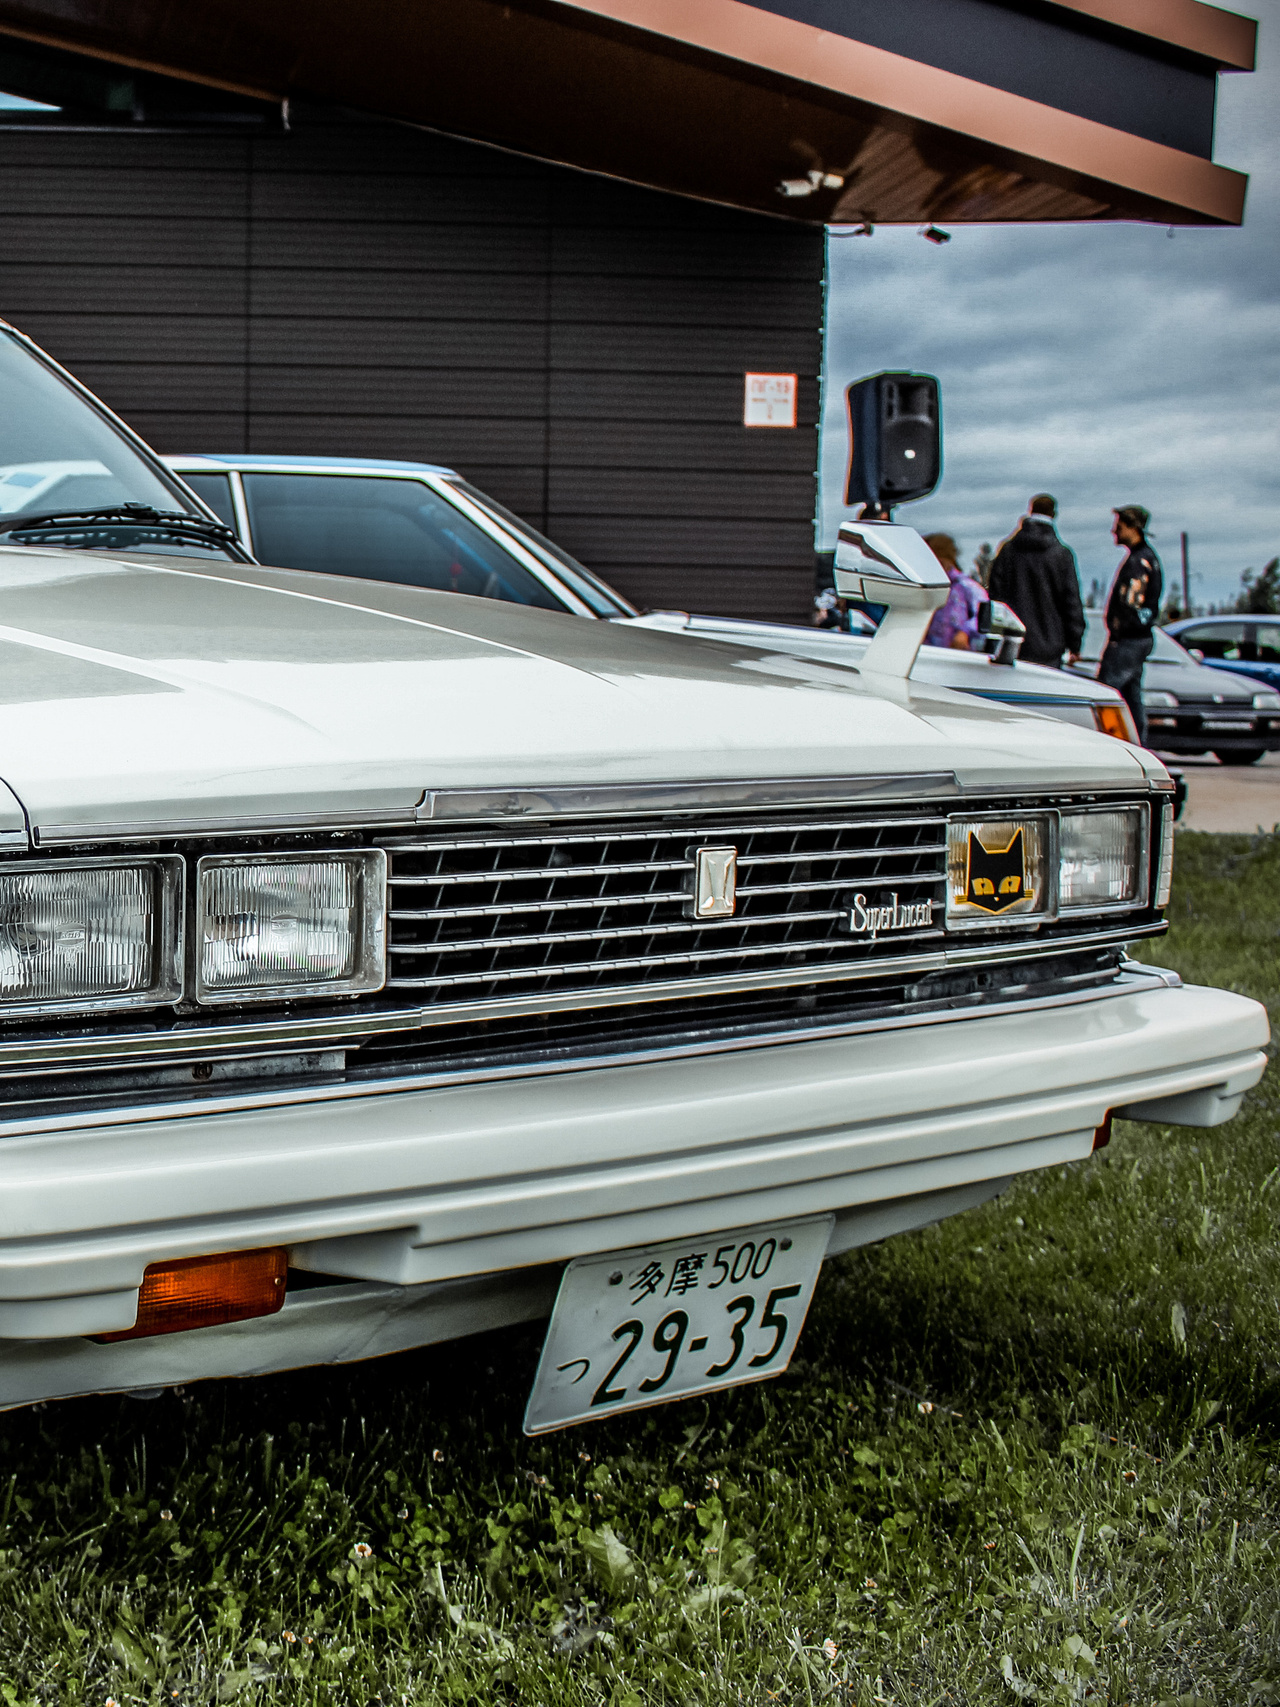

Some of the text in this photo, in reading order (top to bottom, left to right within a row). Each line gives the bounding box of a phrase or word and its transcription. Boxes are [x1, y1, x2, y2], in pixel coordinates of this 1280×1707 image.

[629, 1237, 777, 1306] 多摩 500
[556, 1283, 802, 1407] つ 29-35
